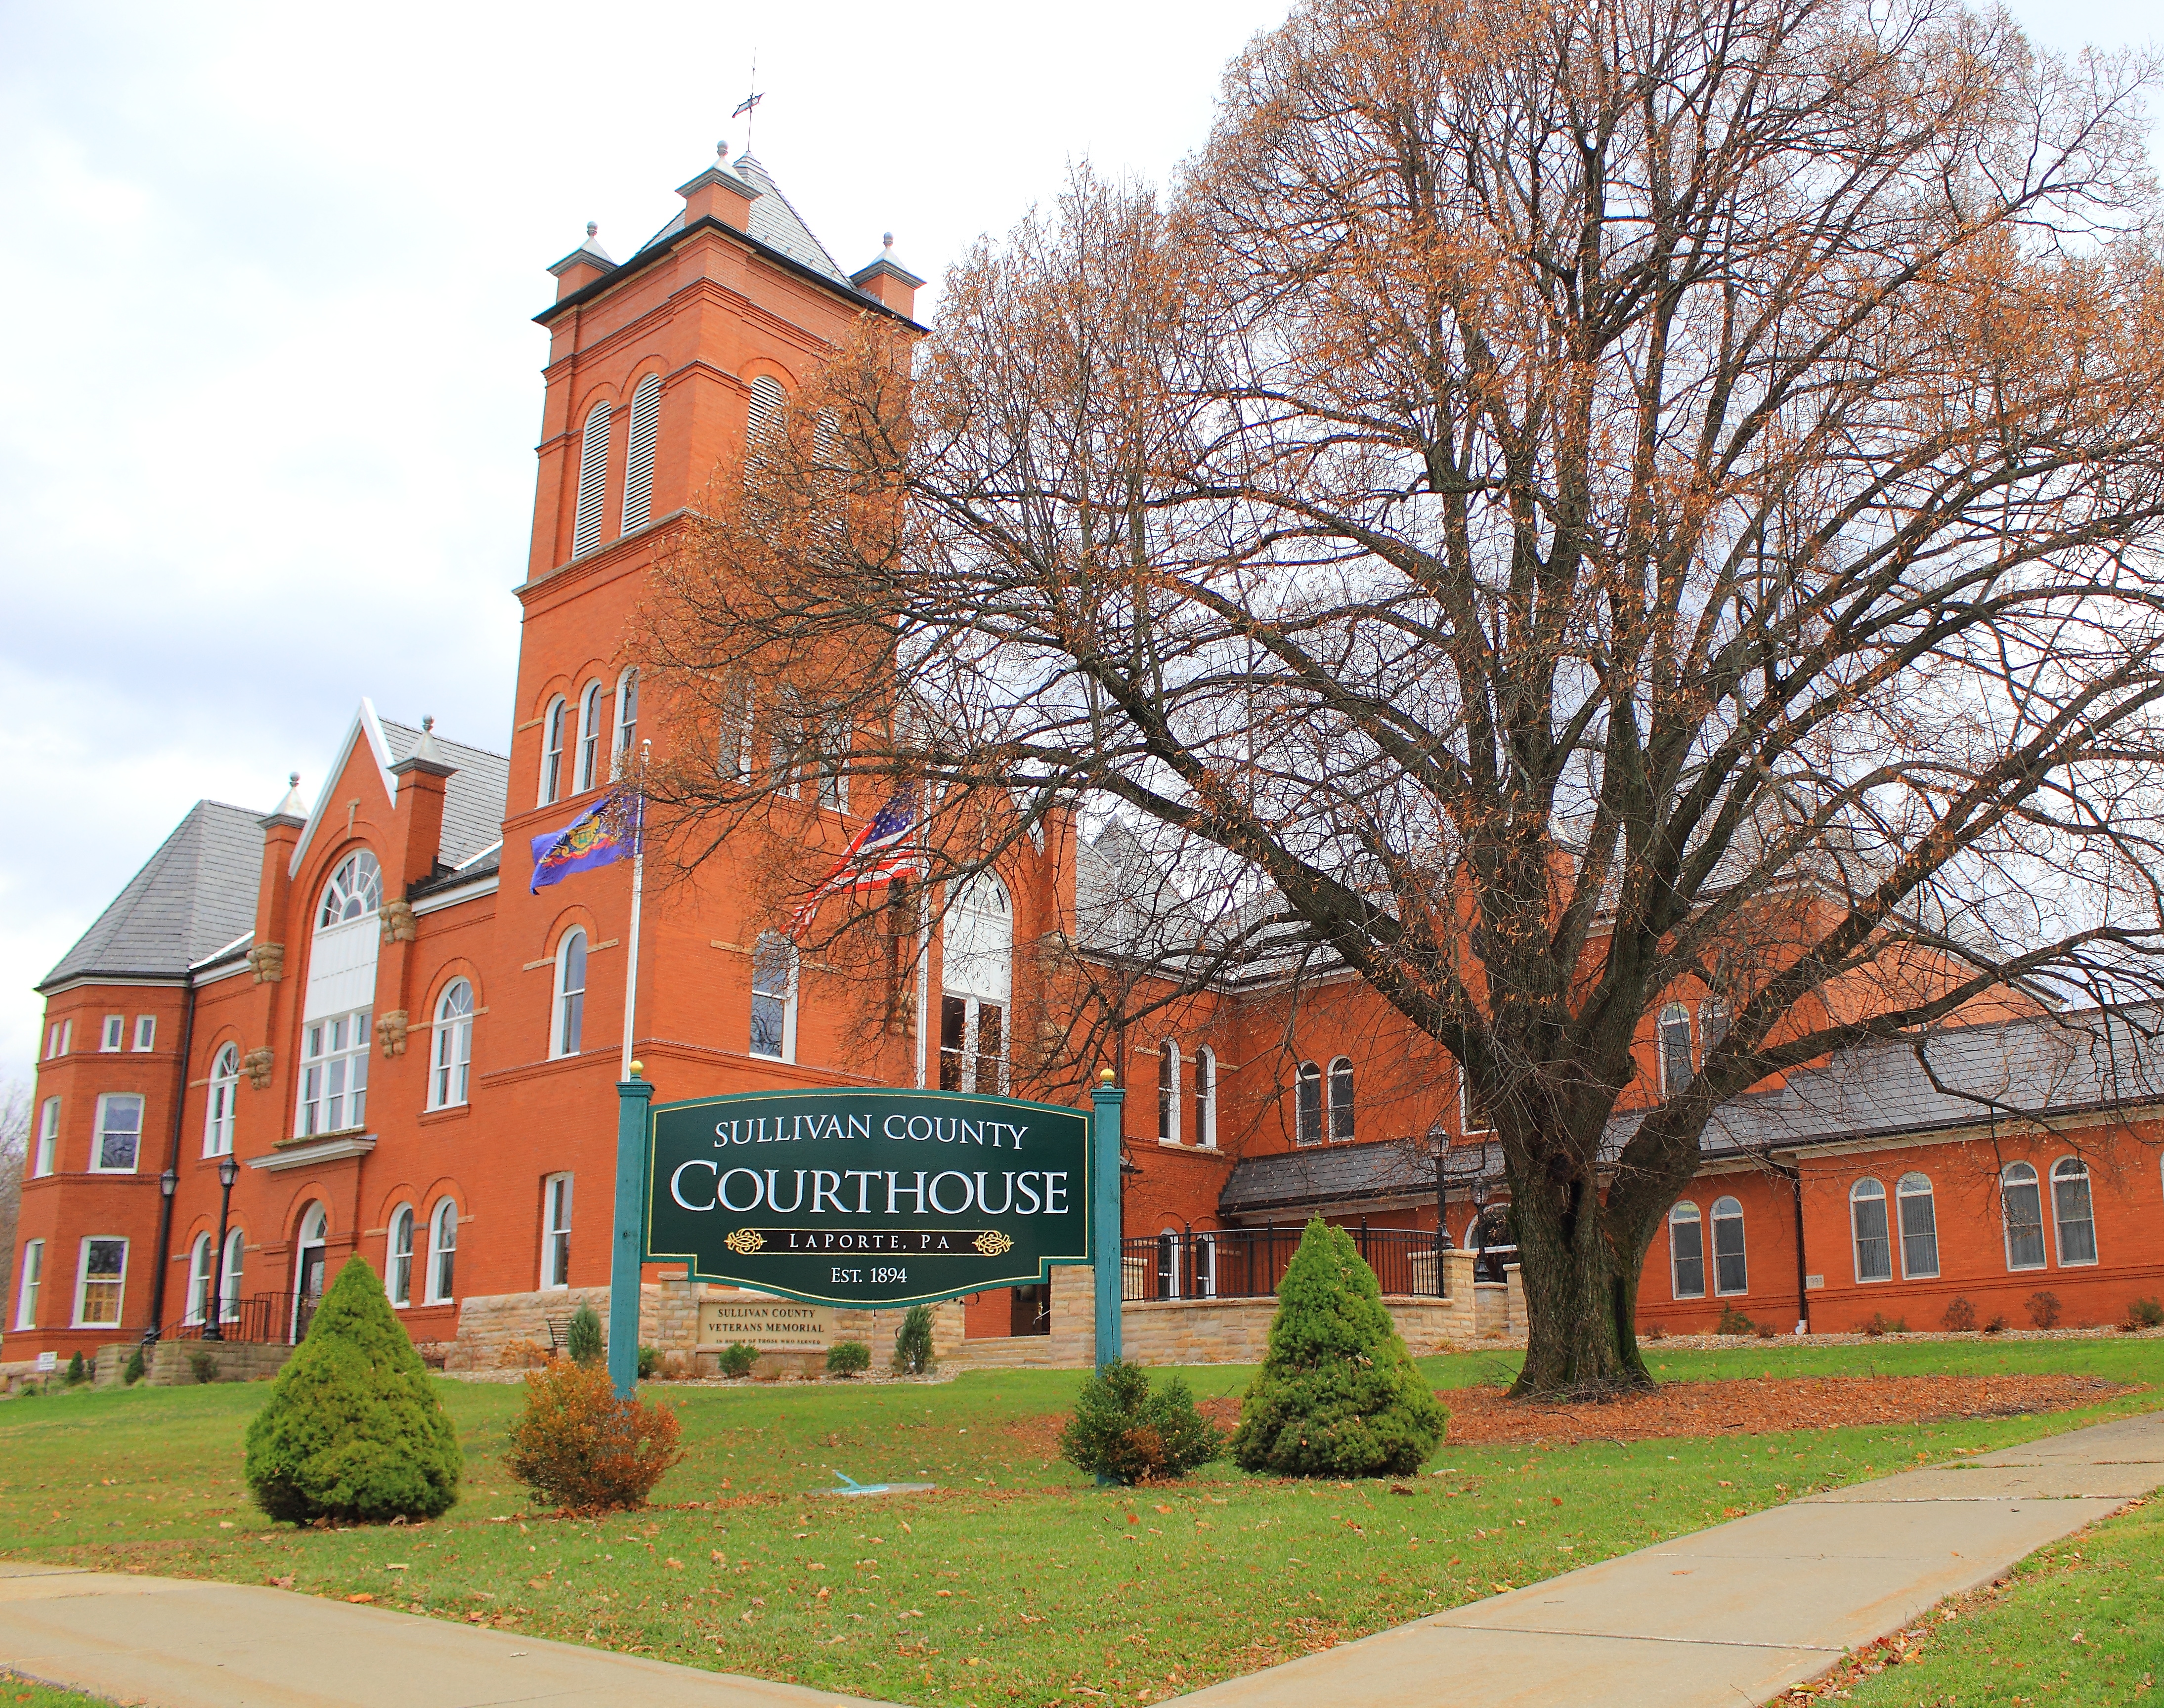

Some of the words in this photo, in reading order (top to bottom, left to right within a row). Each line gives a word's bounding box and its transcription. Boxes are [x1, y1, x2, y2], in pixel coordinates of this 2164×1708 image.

[714, 1114, 872, 1148] SULLIVAN
[884, 1114, 1029, 1150] COUNTY
[670, 1159, 1069, 1215] COURTHOUSE
[921, 1234, 950, 1249] PA
[870, 1267, 908, 1283] 1894
[718, 1309, 768, 1317] SULLIVAN
[772, 1309, 815, 1318] COUNTY
[709, 1324, 762, 1332] VETERANS
[766, 1324, 824, 1332] MEMORIAL
